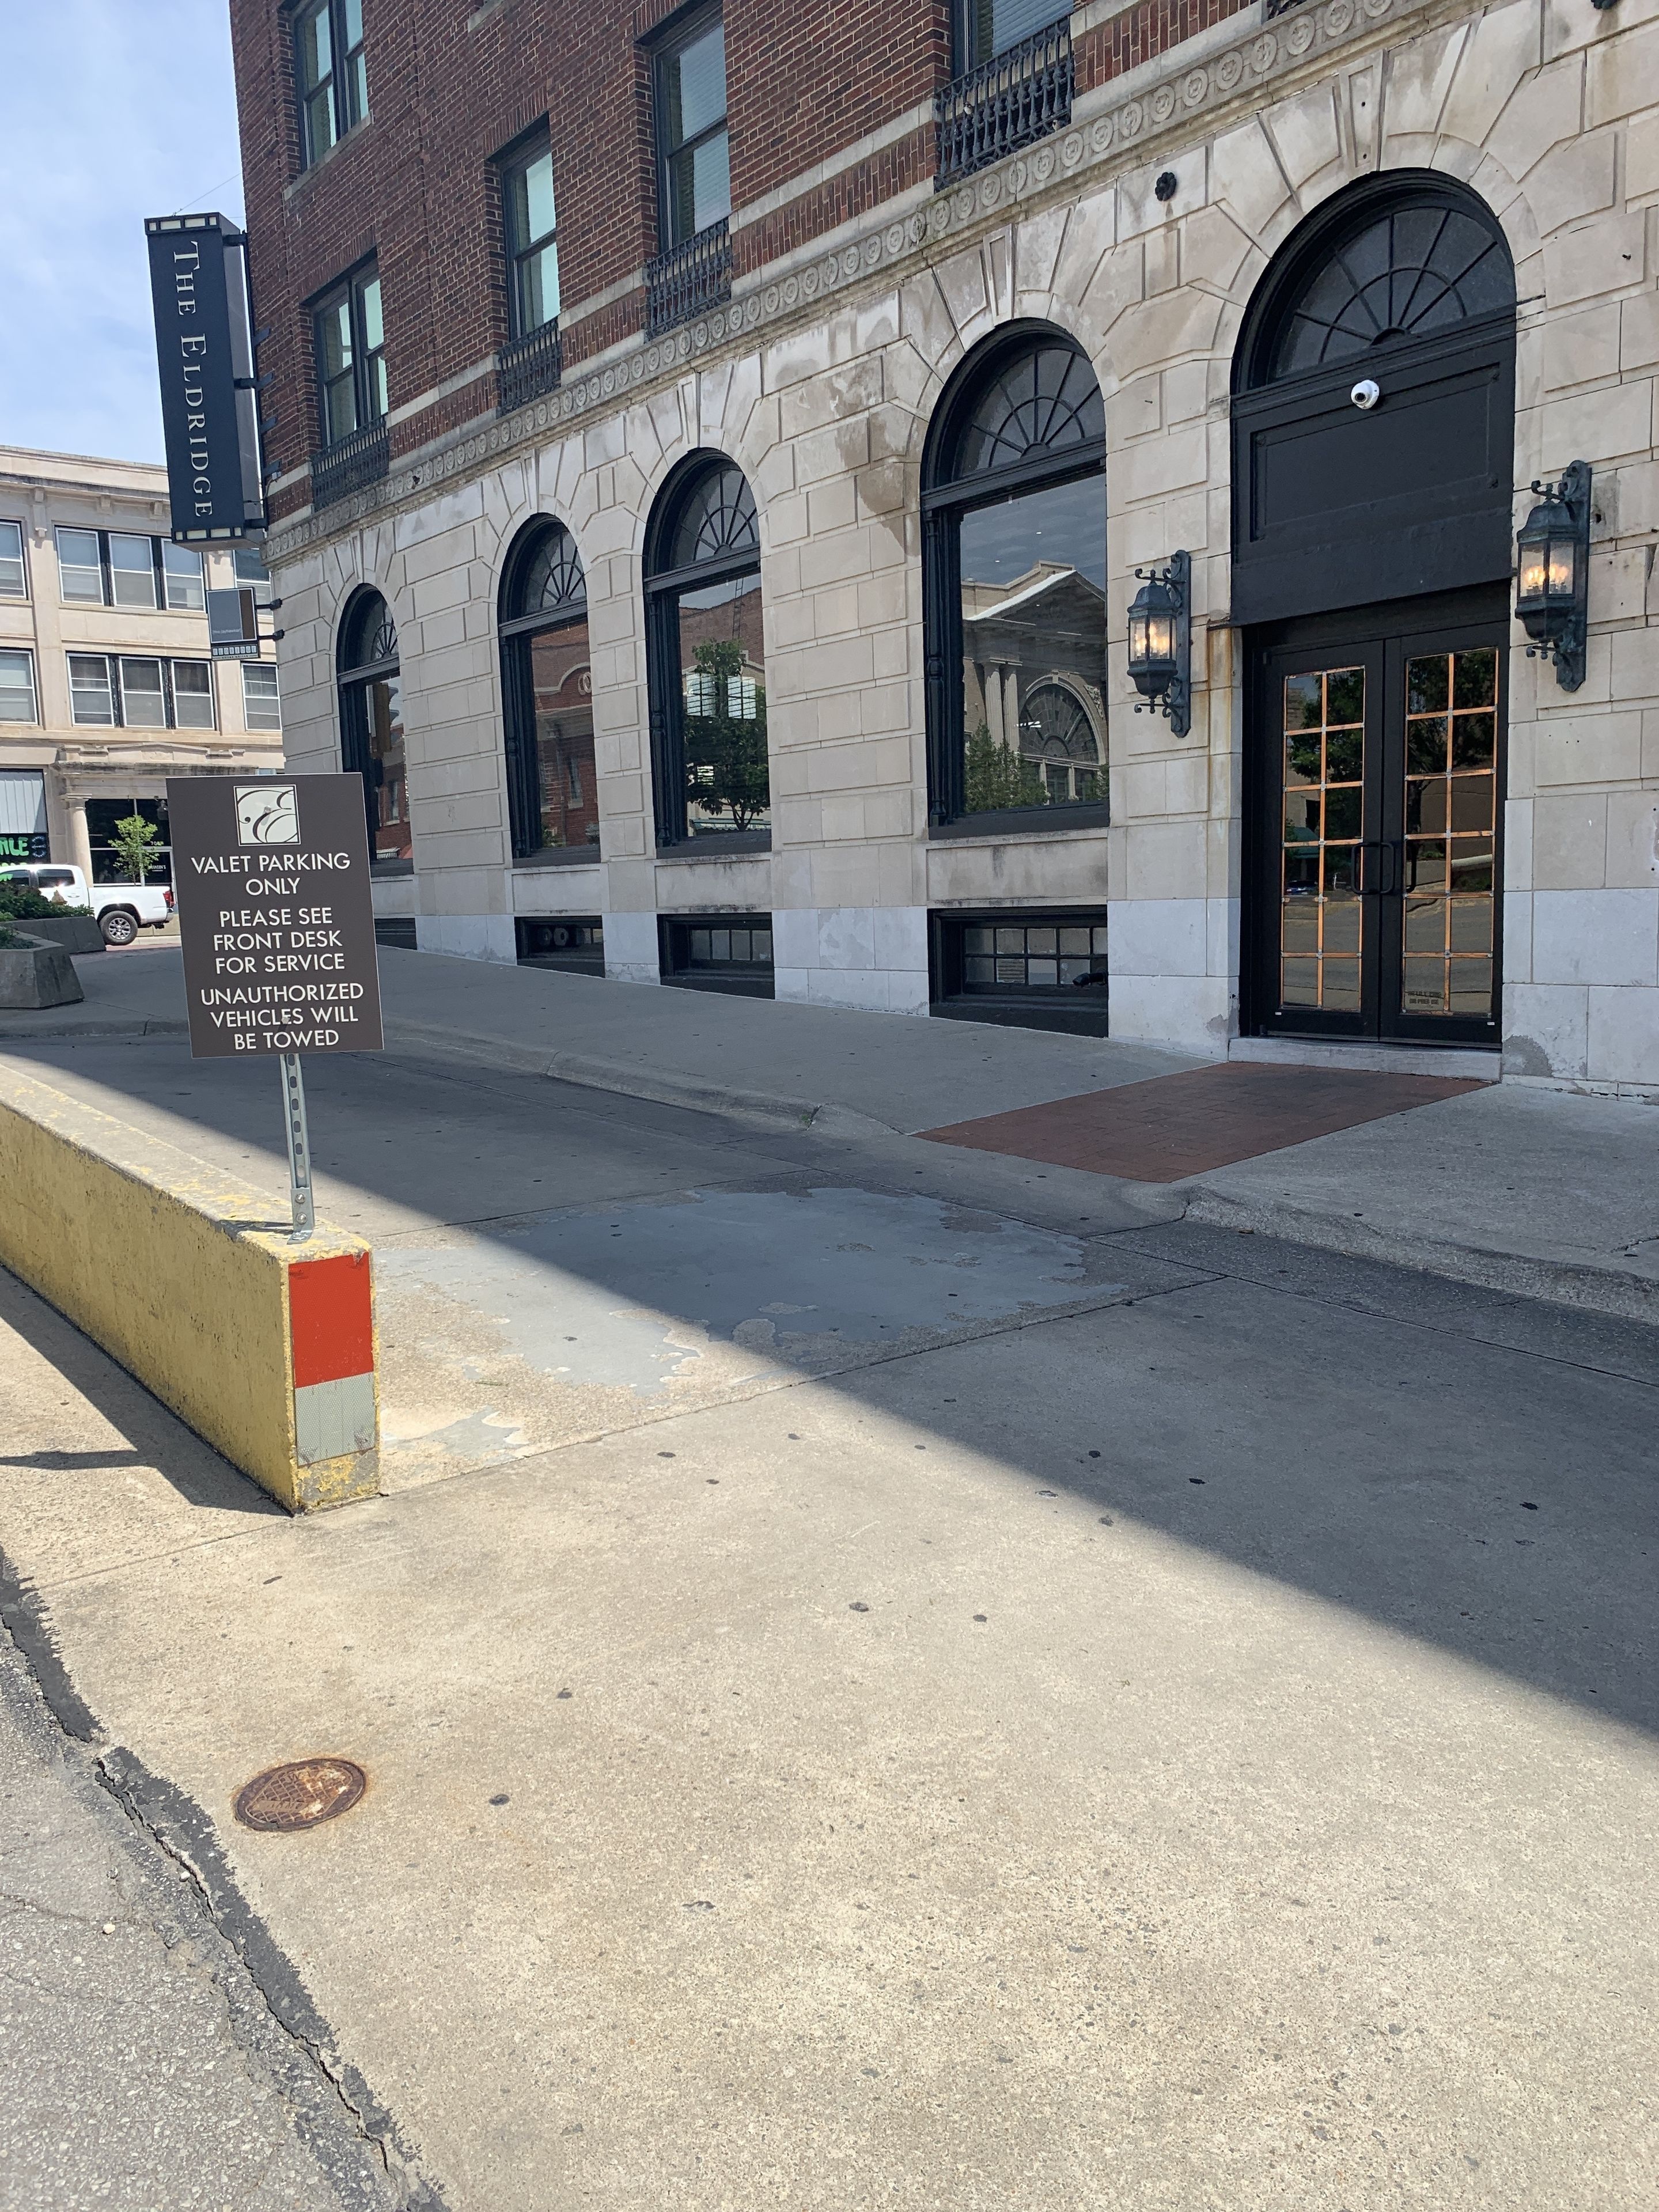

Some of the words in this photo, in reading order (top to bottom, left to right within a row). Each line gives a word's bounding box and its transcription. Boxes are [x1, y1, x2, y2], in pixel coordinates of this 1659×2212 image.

[180, 333, 213, 517] ELDRIDGE
[191, 855, 251, 874] VALET
[259, 852, 350, 872] PARKING
[245, 877, 301, 896] ONLY
[219, 908, 292, 927] PLEASE
[298, 907, 332, 925] SEE
[213, 932, 283, 951] FRONT
[290, 930, 343, 948] DESK
[215, 957, 257, 974] FOR
[264, 953, 345, 972] SERVICE
[201, 983, 363, 1005] UNAUTHORIZED
[210, 1008, 304, 1028] VEHICLES
[310, 1006, 359, 1024] WILL
[234, 1033, 257, 1050] BE
[263, 1029, 339, 1048] TOWED
